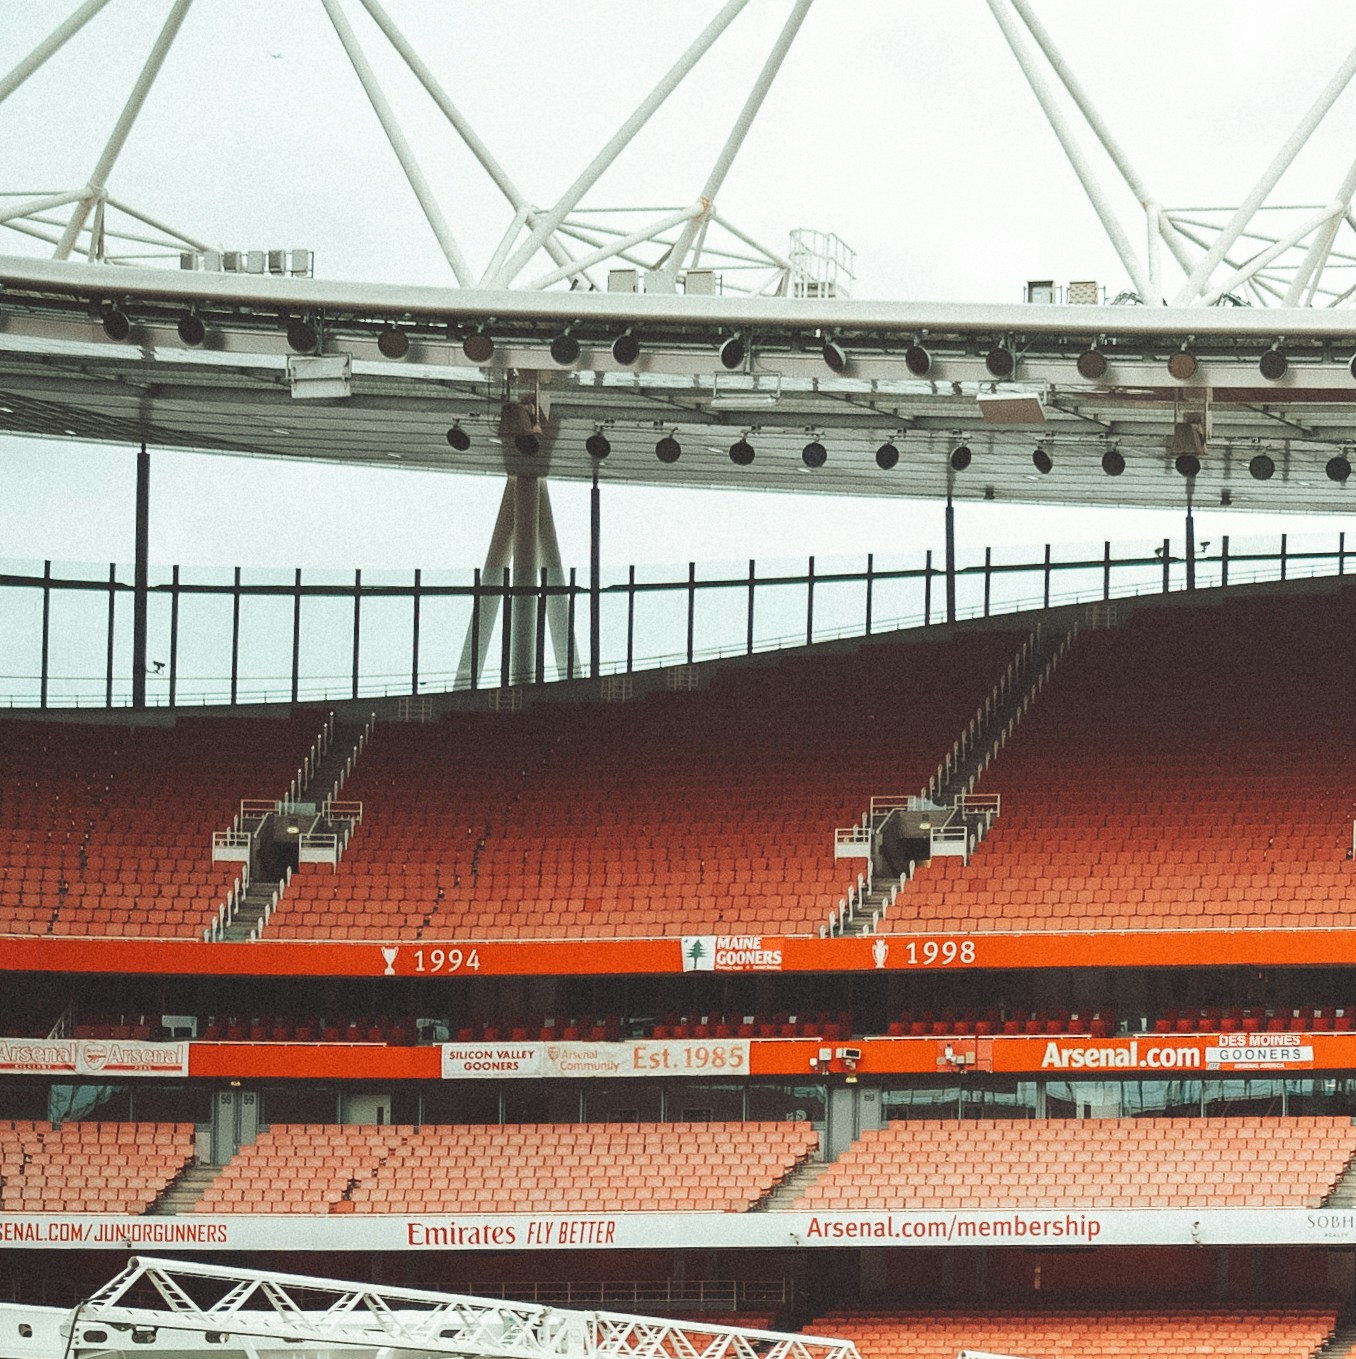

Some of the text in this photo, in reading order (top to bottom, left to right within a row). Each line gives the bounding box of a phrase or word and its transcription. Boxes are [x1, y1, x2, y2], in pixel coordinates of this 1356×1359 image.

[717, 937, 762, 950] MAINE
[716, 950, 782, 965] GOONERS
[905, 941, 976, 964] 1998
[413, 949, 481, 972] 1994
[1219, 1035, 1301, 1046] DES MOINES
[0, 1040, 77, 1063] Arsenal
[107, 1043, 183, 1064] Arsenal
[449, 1050, 535, 1060] SILICON VALLEY
[560, 1050, 598, 1060] Arsenal
[1041, 1041, 1200, 1068] Arsenal.com
[1219, 1049, 1301, 1060] GOONERS
[463, 1060, 520, 1071] GOONERS
[559, 1060, 620, 1072] Community
[407, 1221, 616, 1246] Emirates FLY BETTER
[806, 1215, 1101, 1241] Arsenal.com/membership
